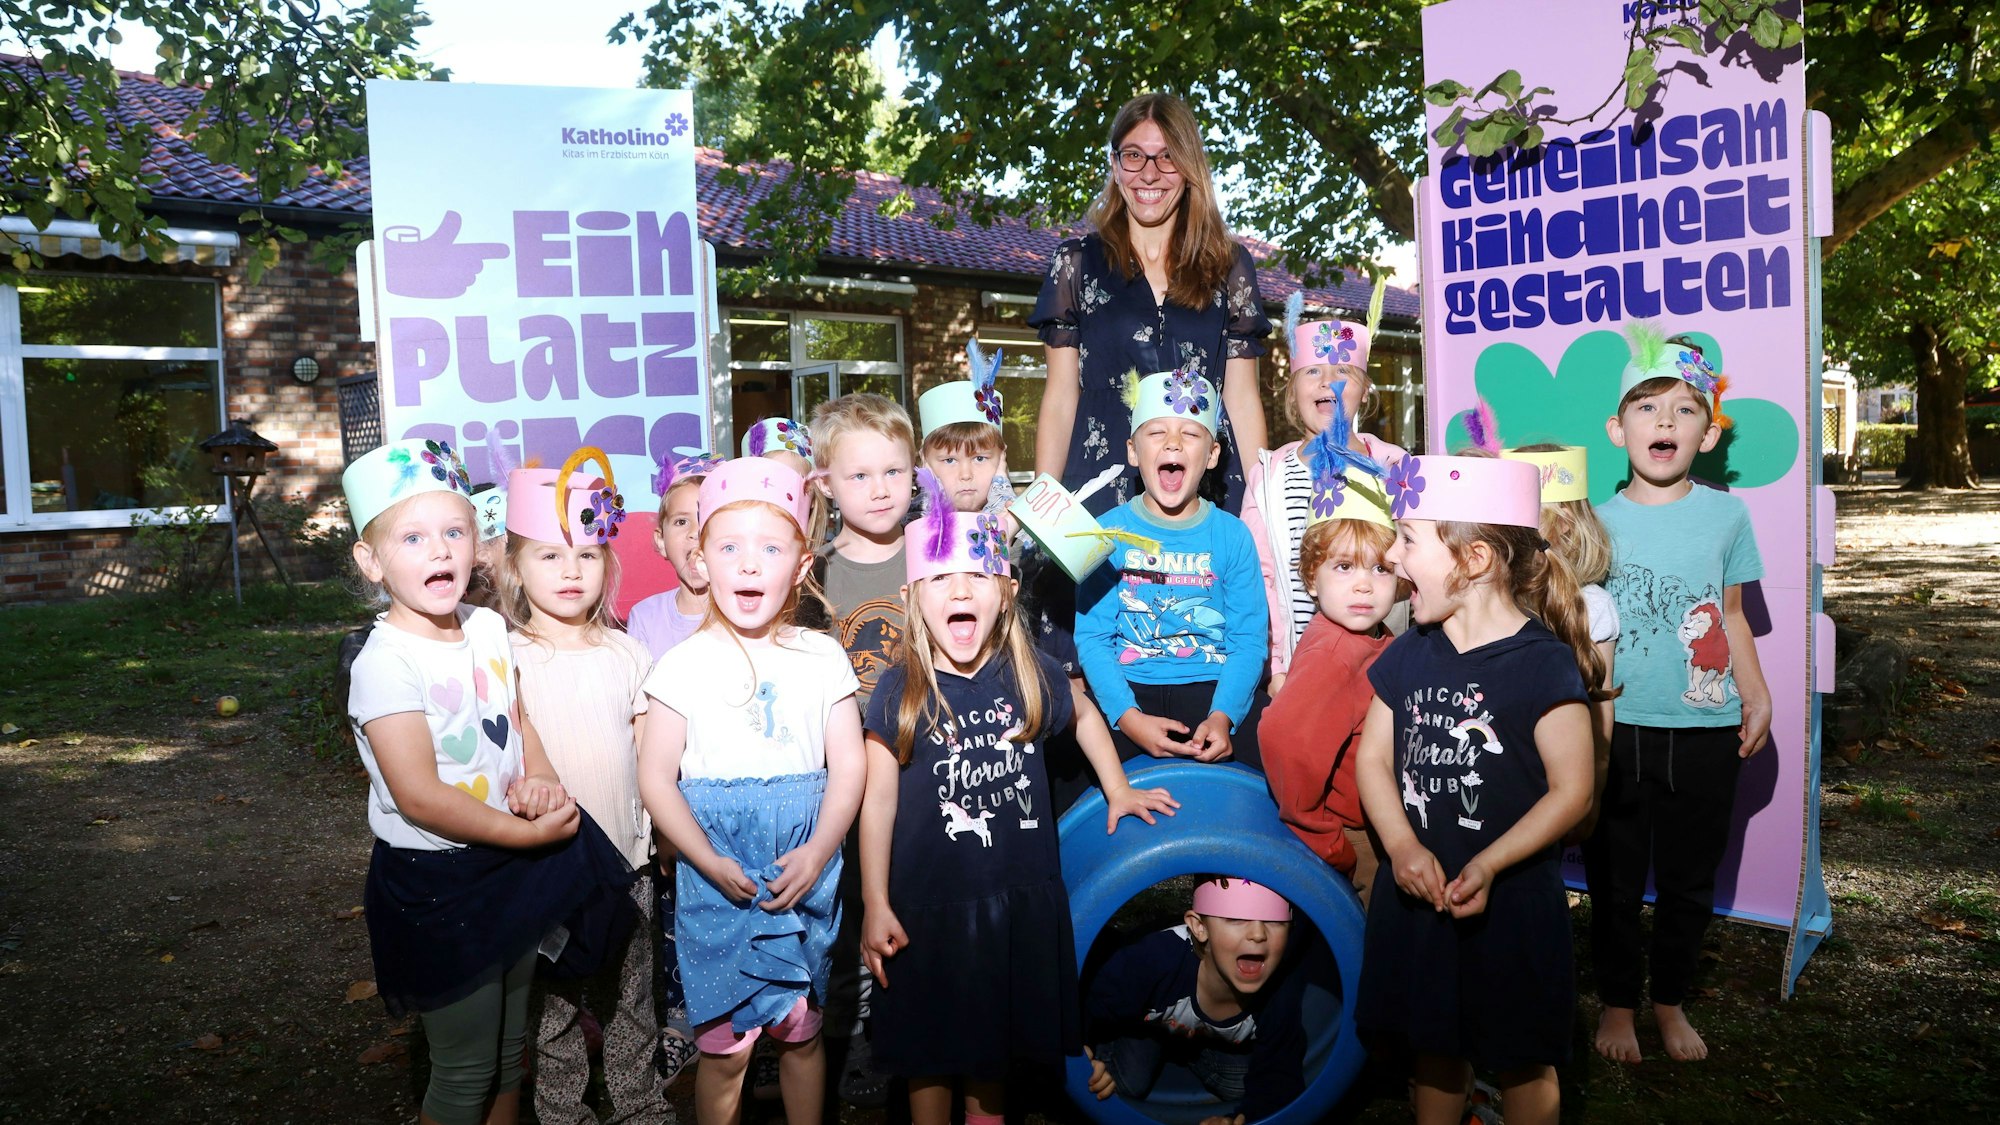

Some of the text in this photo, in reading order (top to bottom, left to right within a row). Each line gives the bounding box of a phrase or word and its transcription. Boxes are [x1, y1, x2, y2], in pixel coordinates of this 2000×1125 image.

[561, 127, 670, 146] Katholino
[562, 149, 670, 160] Kitas im Erzbistum Köln
[1440, 98, 1788, 209] Gemeinsam
[1441, 173, 1790, 274] Kindheit
[513, 210, 694, 298] Ein
[1444, 245, 1791, 335] gestalten
[390, 311, 699, 407] Platz
[1124, 548, 1212, 575] SONIC
[1404, 687, 1494, 725] UNICORN
[1422, 711, 1456, 730] AND
[929, 709, 1024, 746] UNICORN
[963, 733, 997, 751] AND
[1403, 725, 1482, 769] Florals
[932, 745, 1025, 801] Florals
[1411, 769, 1460, 794] CLUB
[961, 786, 1016, 811] CLUB
